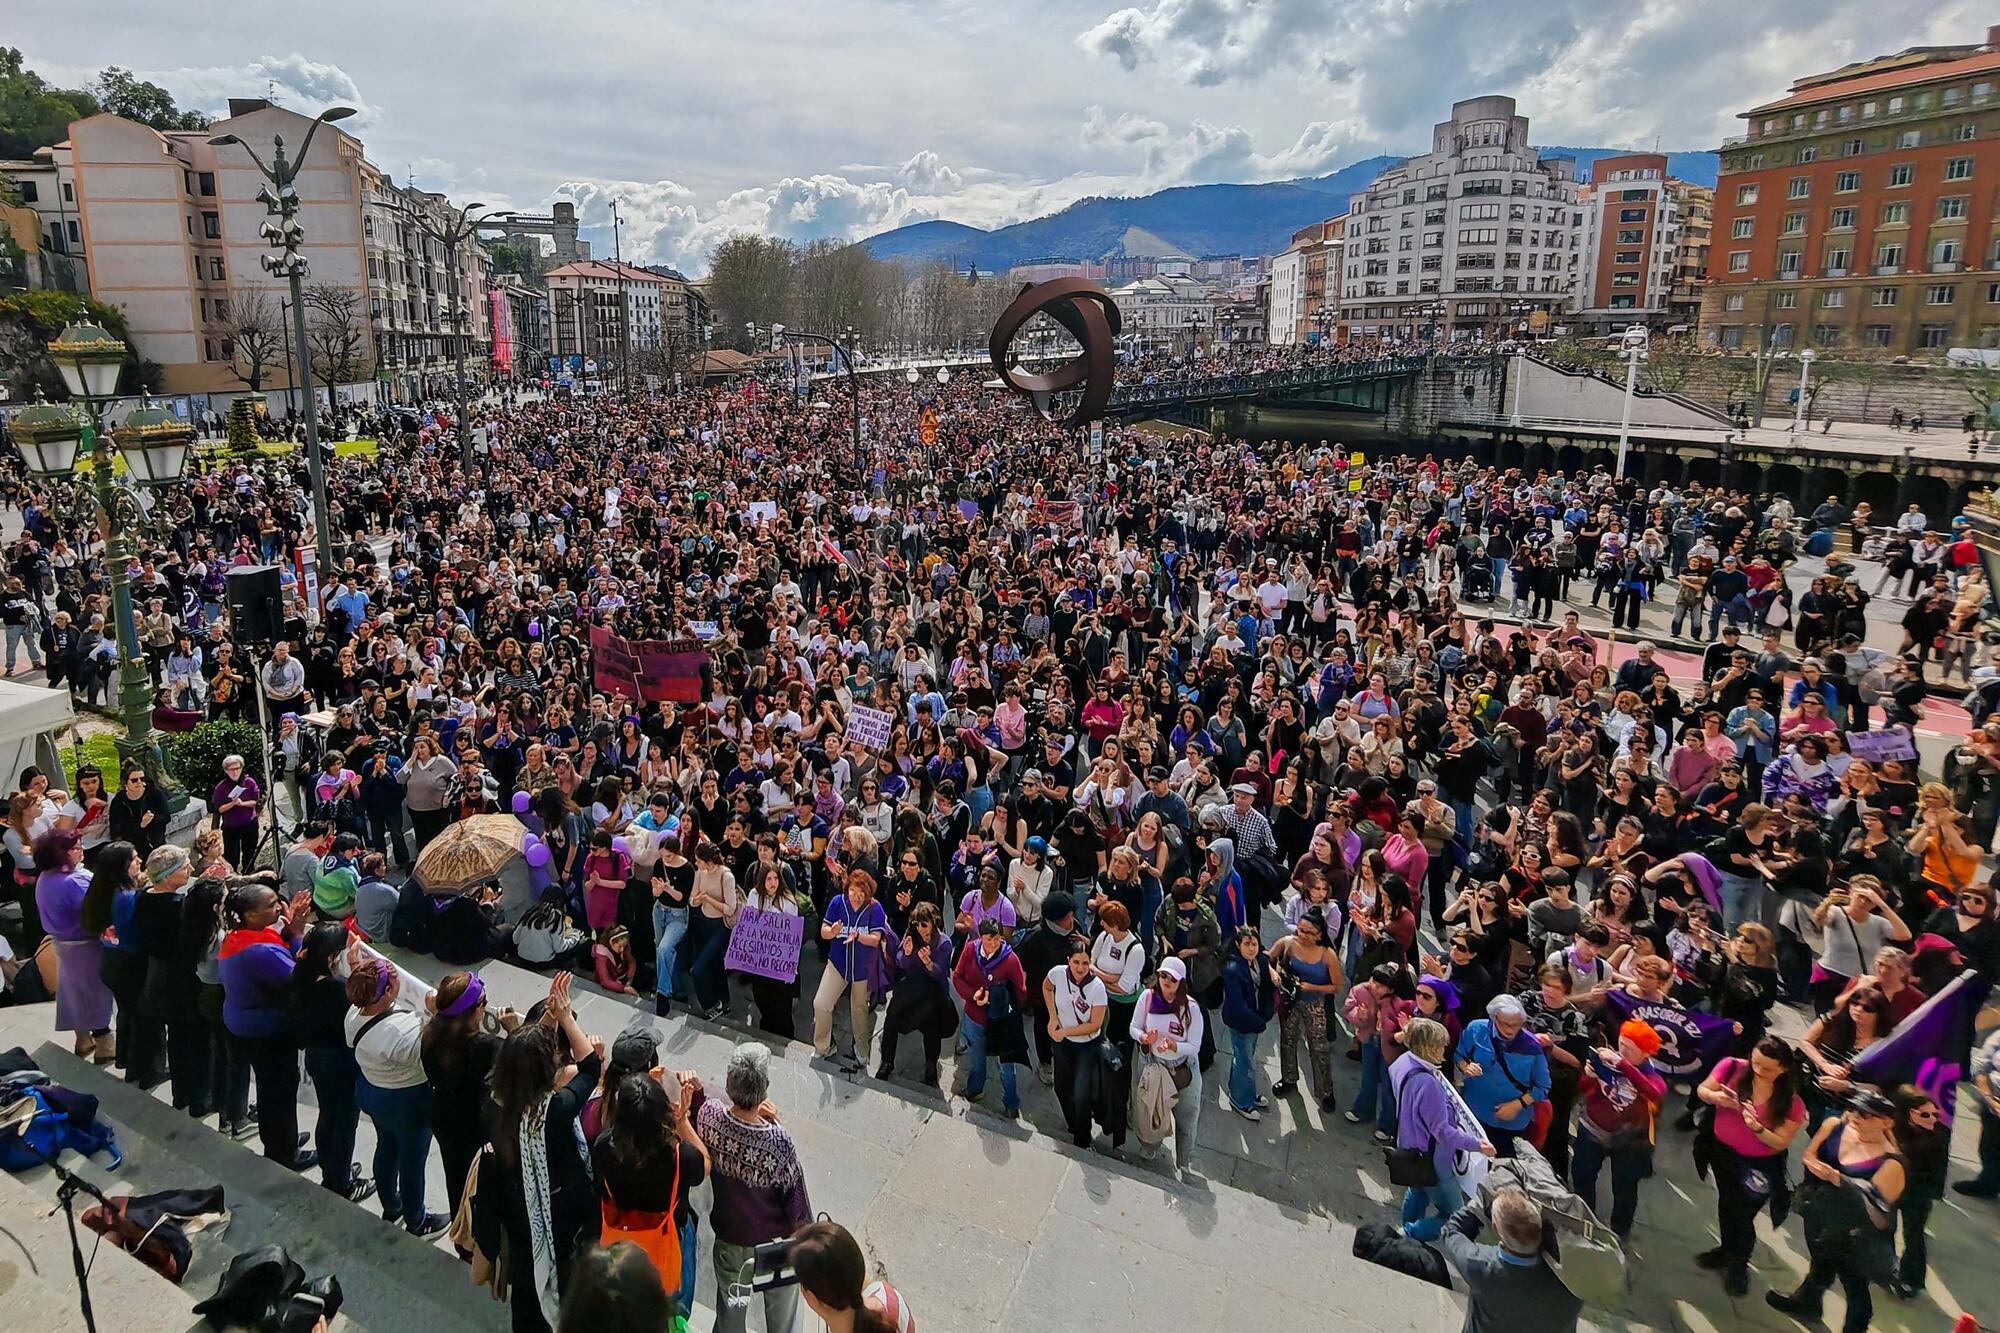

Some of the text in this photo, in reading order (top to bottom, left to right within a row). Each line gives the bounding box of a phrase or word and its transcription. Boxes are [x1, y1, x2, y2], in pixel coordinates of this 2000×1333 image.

[763, 914, 791, 930] SALIR
[736, 925, 800, 946] DE LA VIOLENCIA
[731, 937, 782, 957] NECESITAMOS
[758, 957, 769, 967] NO
